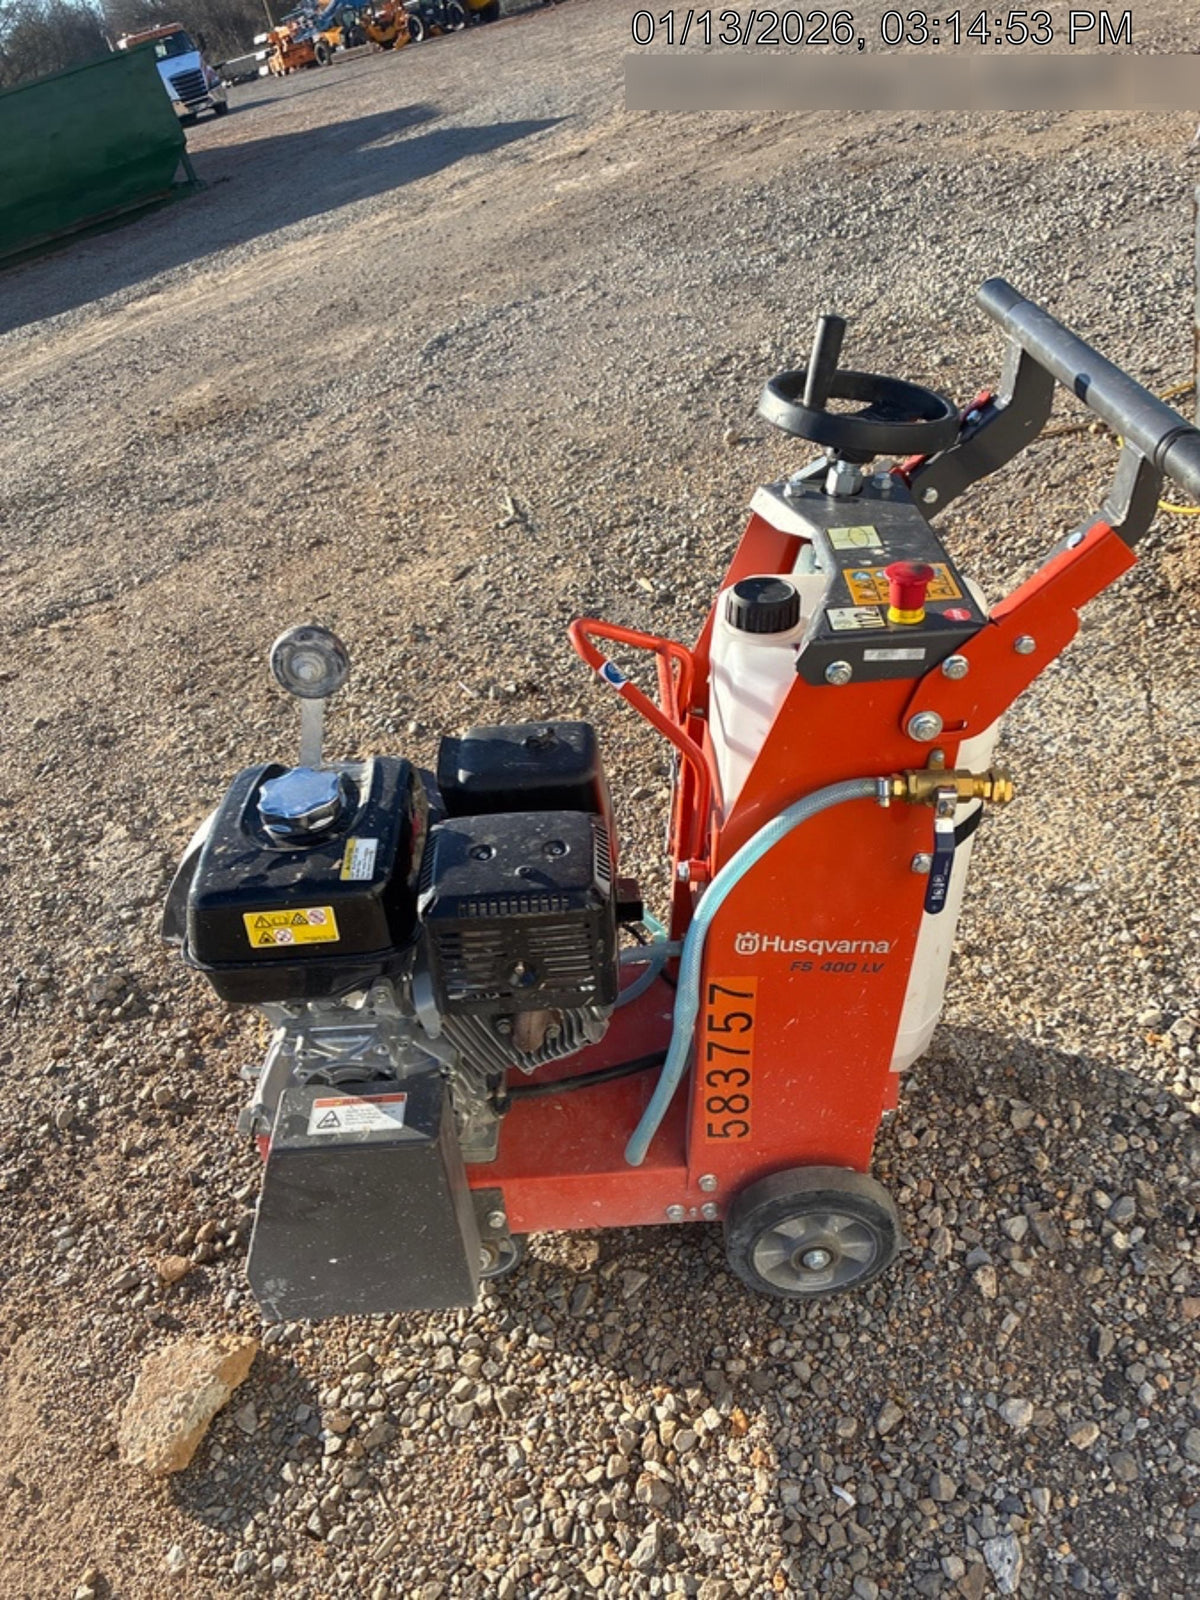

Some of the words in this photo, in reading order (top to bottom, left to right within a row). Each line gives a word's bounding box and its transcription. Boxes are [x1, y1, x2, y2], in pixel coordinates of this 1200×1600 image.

[761, 935, 890, 956] Husqvarna
[790, 961, 814, 972] FS
[819, 961, 857, 973] 400
[860, 962, 884, 974] LV
[706, 983, 754, 1138] 583757
